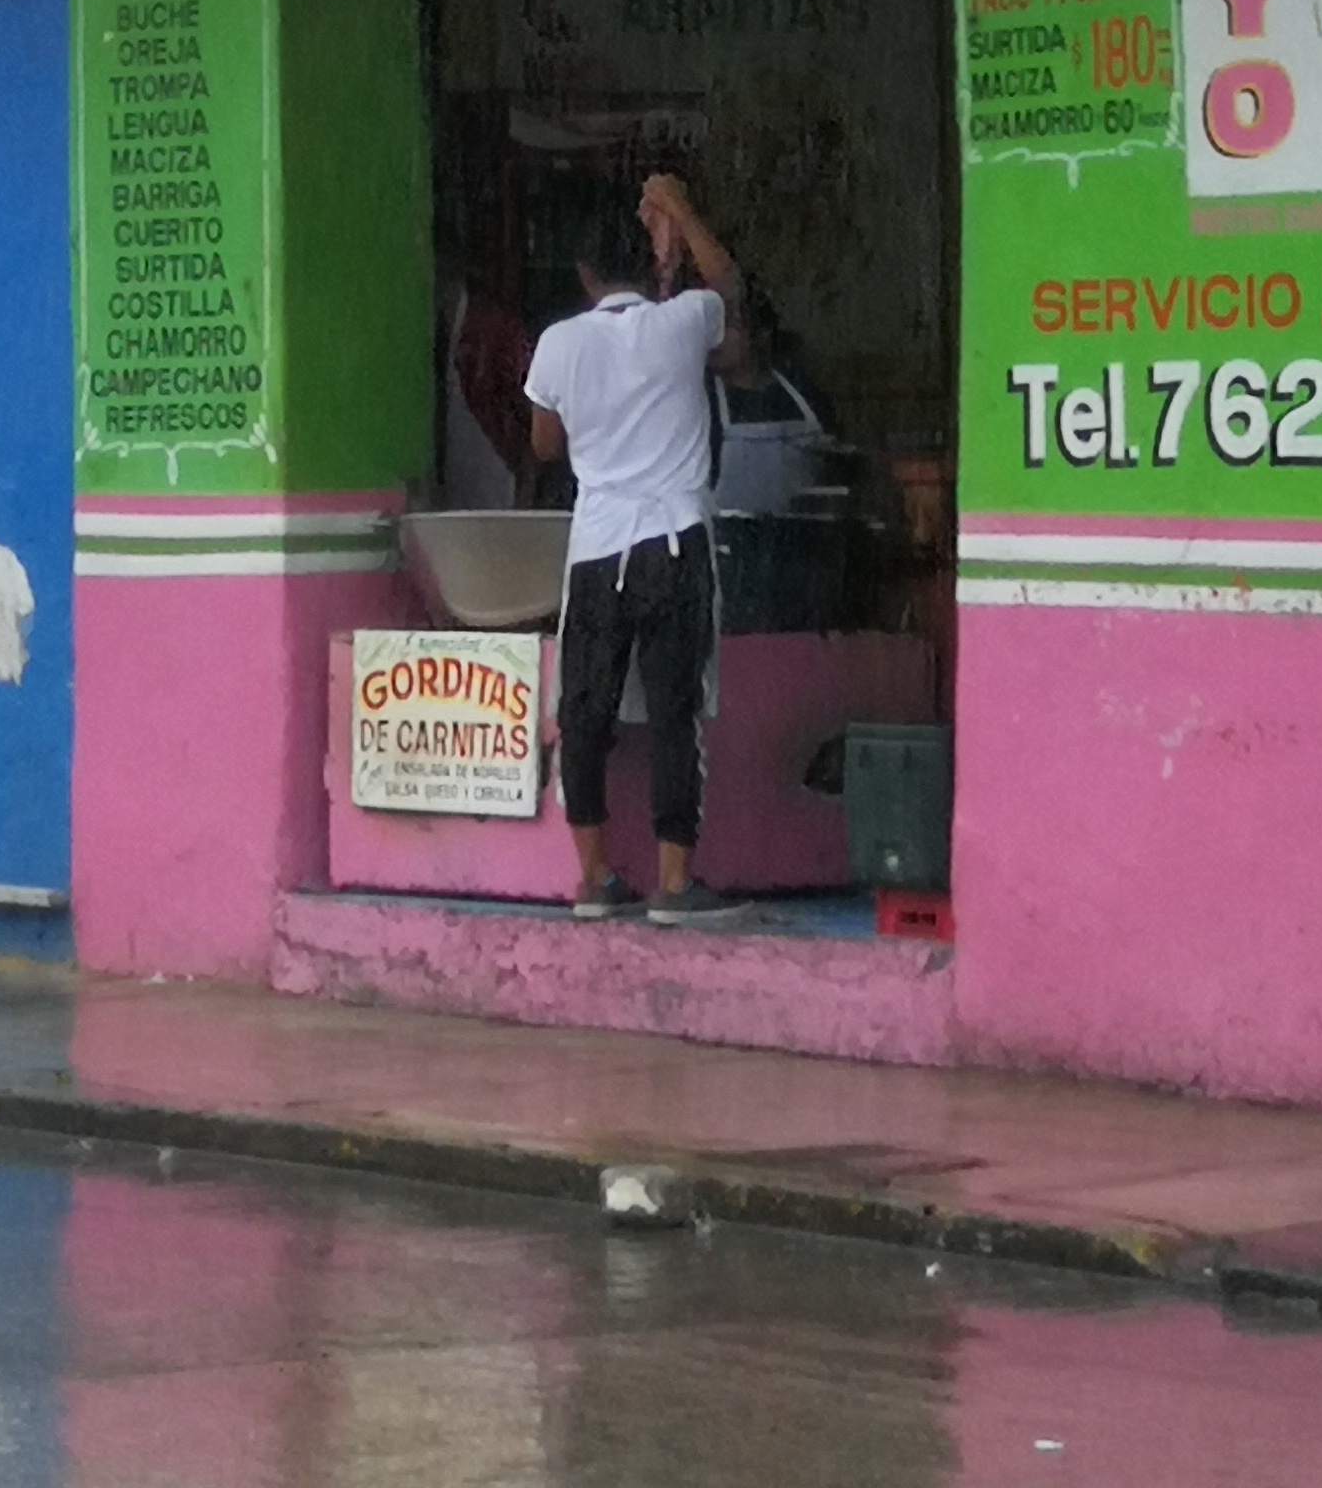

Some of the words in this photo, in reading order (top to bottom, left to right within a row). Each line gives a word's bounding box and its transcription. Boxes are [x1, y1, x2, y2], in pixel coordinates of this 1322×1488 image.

[116, 0, 201, 34] BUCHE
[117, 38, 202, 69] OREJA
[968, 23, 1067, 61] SURTIDA
[108, 72, 210, 106] TROMPA
[970, 66, 1057, 102] MACIZA
[107, 108, 210, 142] LENGUA
[969, 103, 1094, 142] CHAMORRO
[1103, 97, 1135, 135] 60
[110, 144, 211, 177] MACIZA
[113, 180, 222, 212] BARRIGA
[114, 215, 224, 249] CUERITO
[115, 252, 227, 285] SURTIDA
[108, 286, 236, 321] COSTILLA
[1030, 270, 1302, 334] SERVICIO
[106, 323, 247, 361] CHAMORRO
[90, 362, 263, 399] CAMPECHANO
[105, 401, 249, 434] REFRESCOS
[360, 657, 533, 722] GORDITAS
[360, 718, 389, 754] DE
[395, 719, 530, 760] CARNITAS
[393, 760, 451, 778] ENSALADA
[384, 780, 419, 798] SALSA
